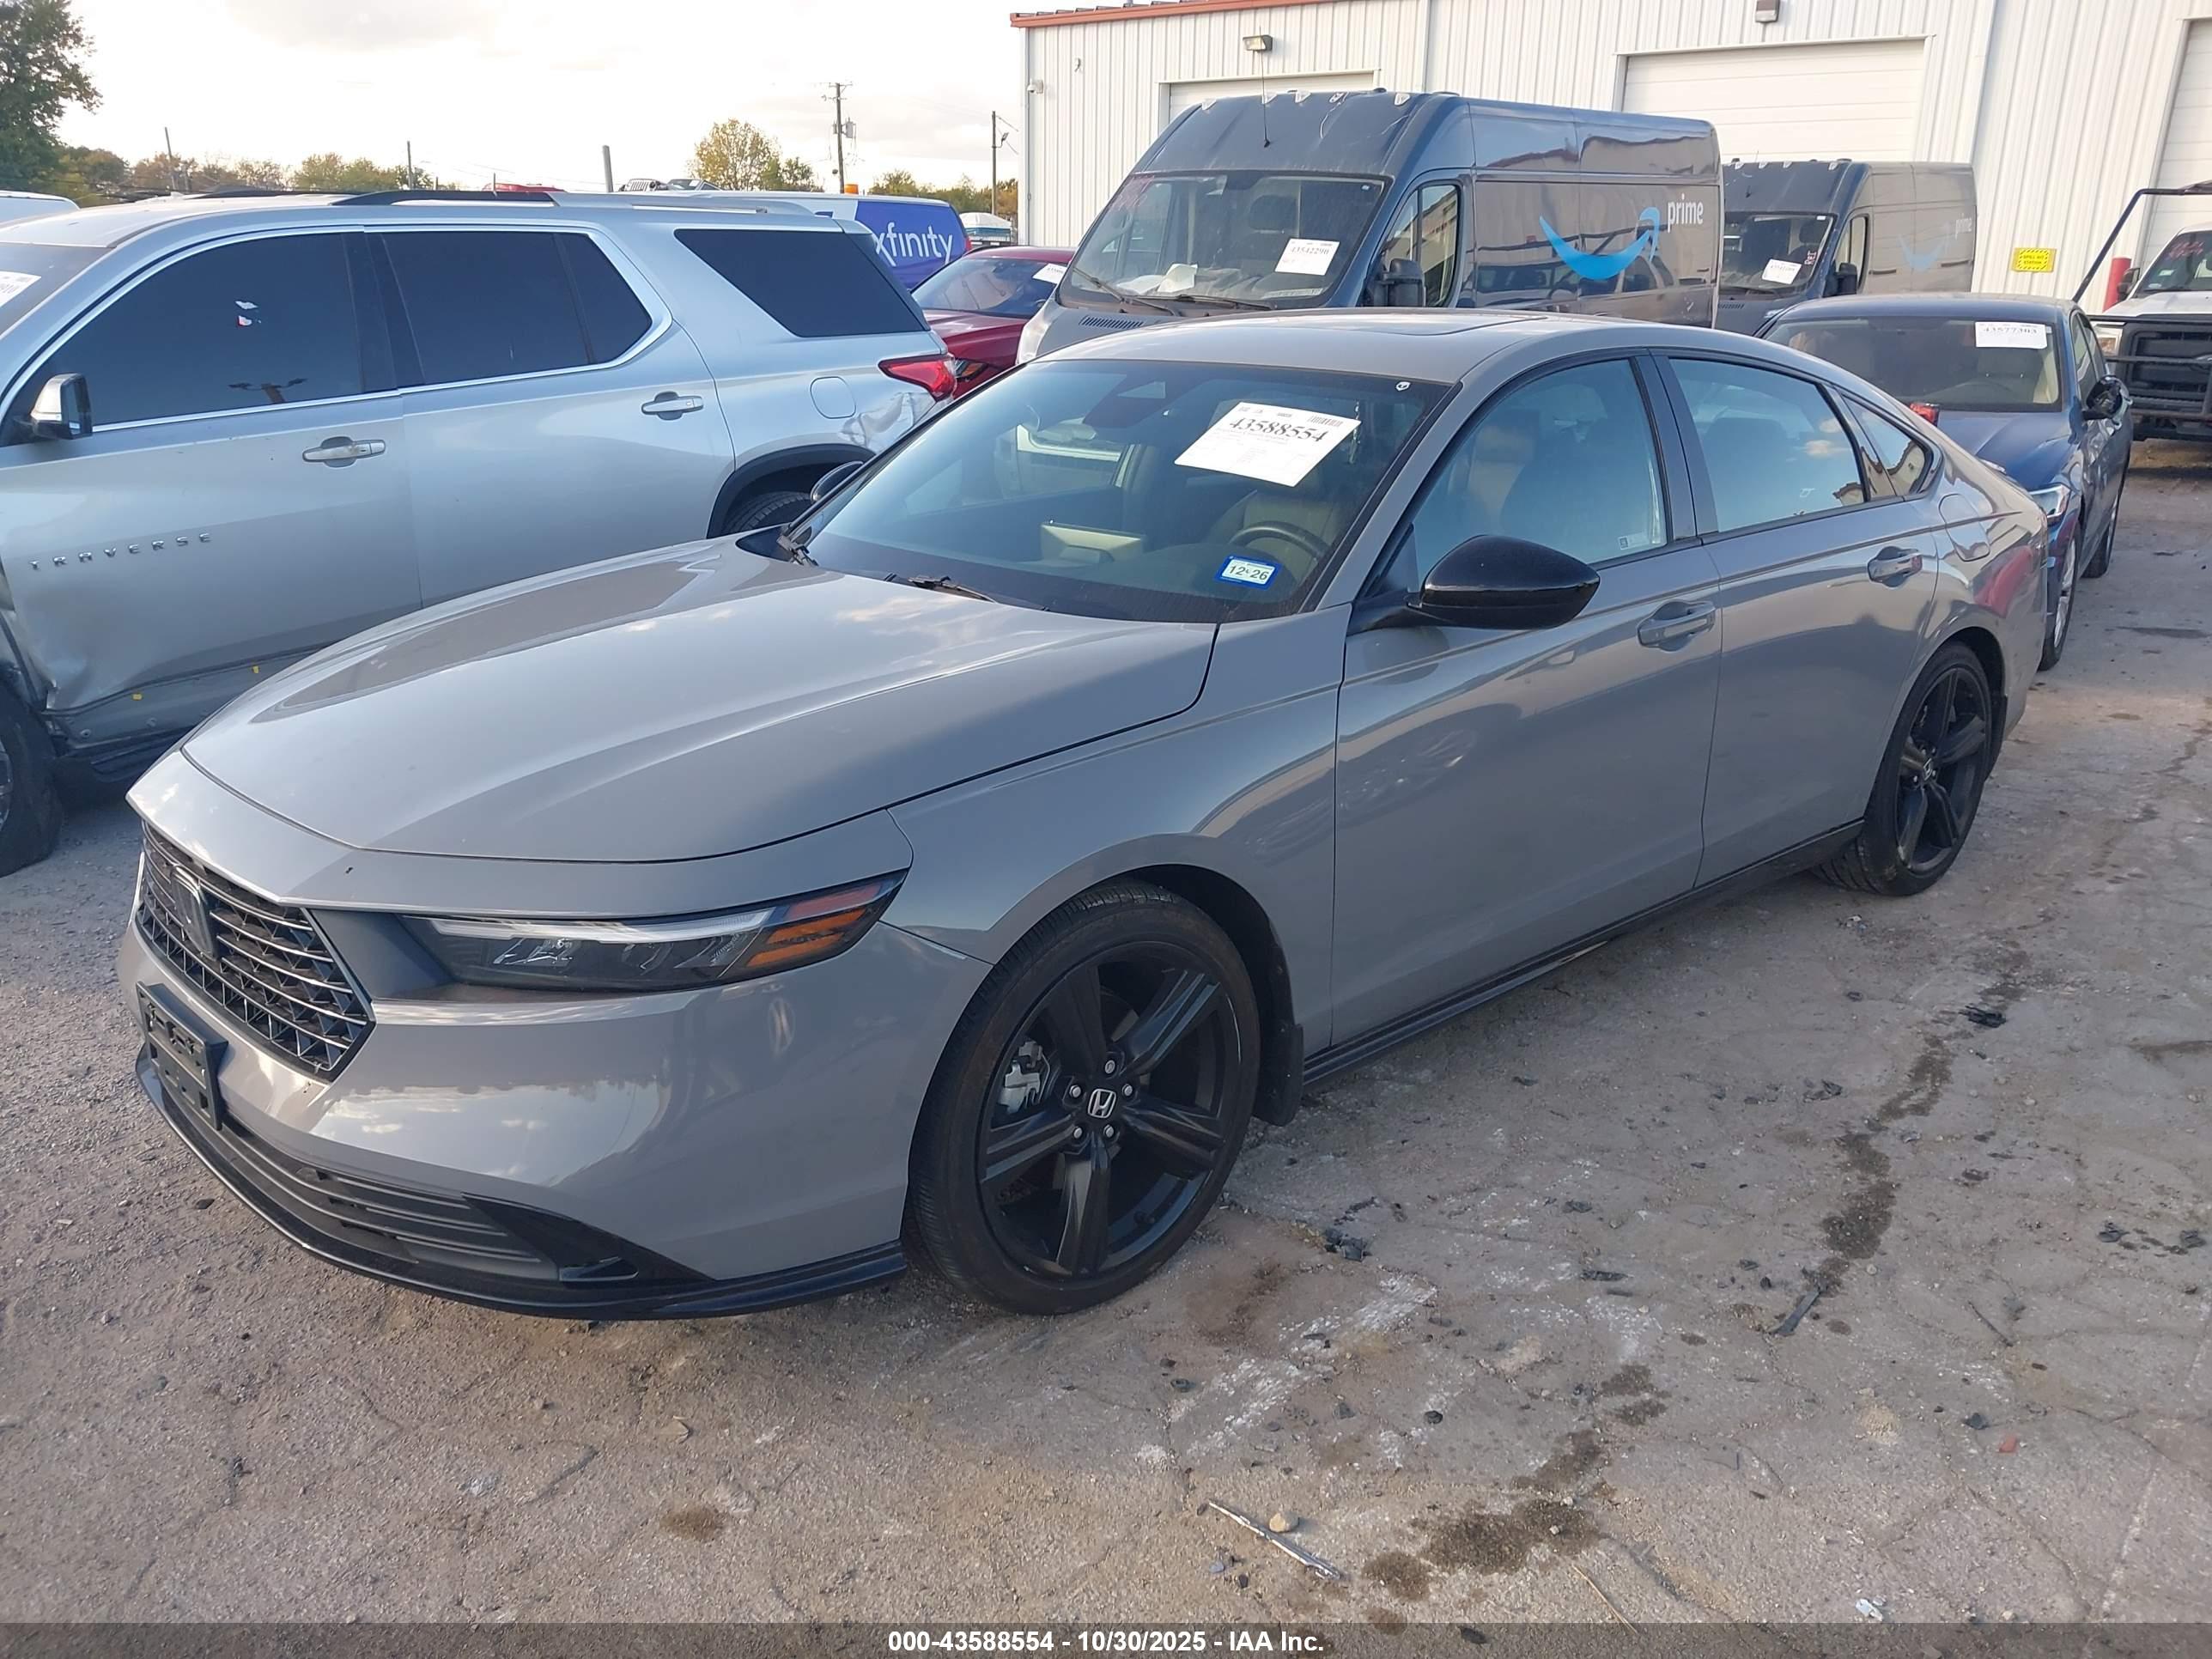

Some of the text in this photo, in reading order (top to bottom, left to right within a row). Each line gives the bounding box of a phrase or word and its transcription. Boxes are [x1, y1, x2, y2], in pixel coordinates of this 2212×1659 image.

[1668, 192, 1704, 233] prime
[875, 222, 952, 267] xfinity
[1229, 417, 1329, 442] 43588554
[29, 532, 210, 570] TRAVERSE
